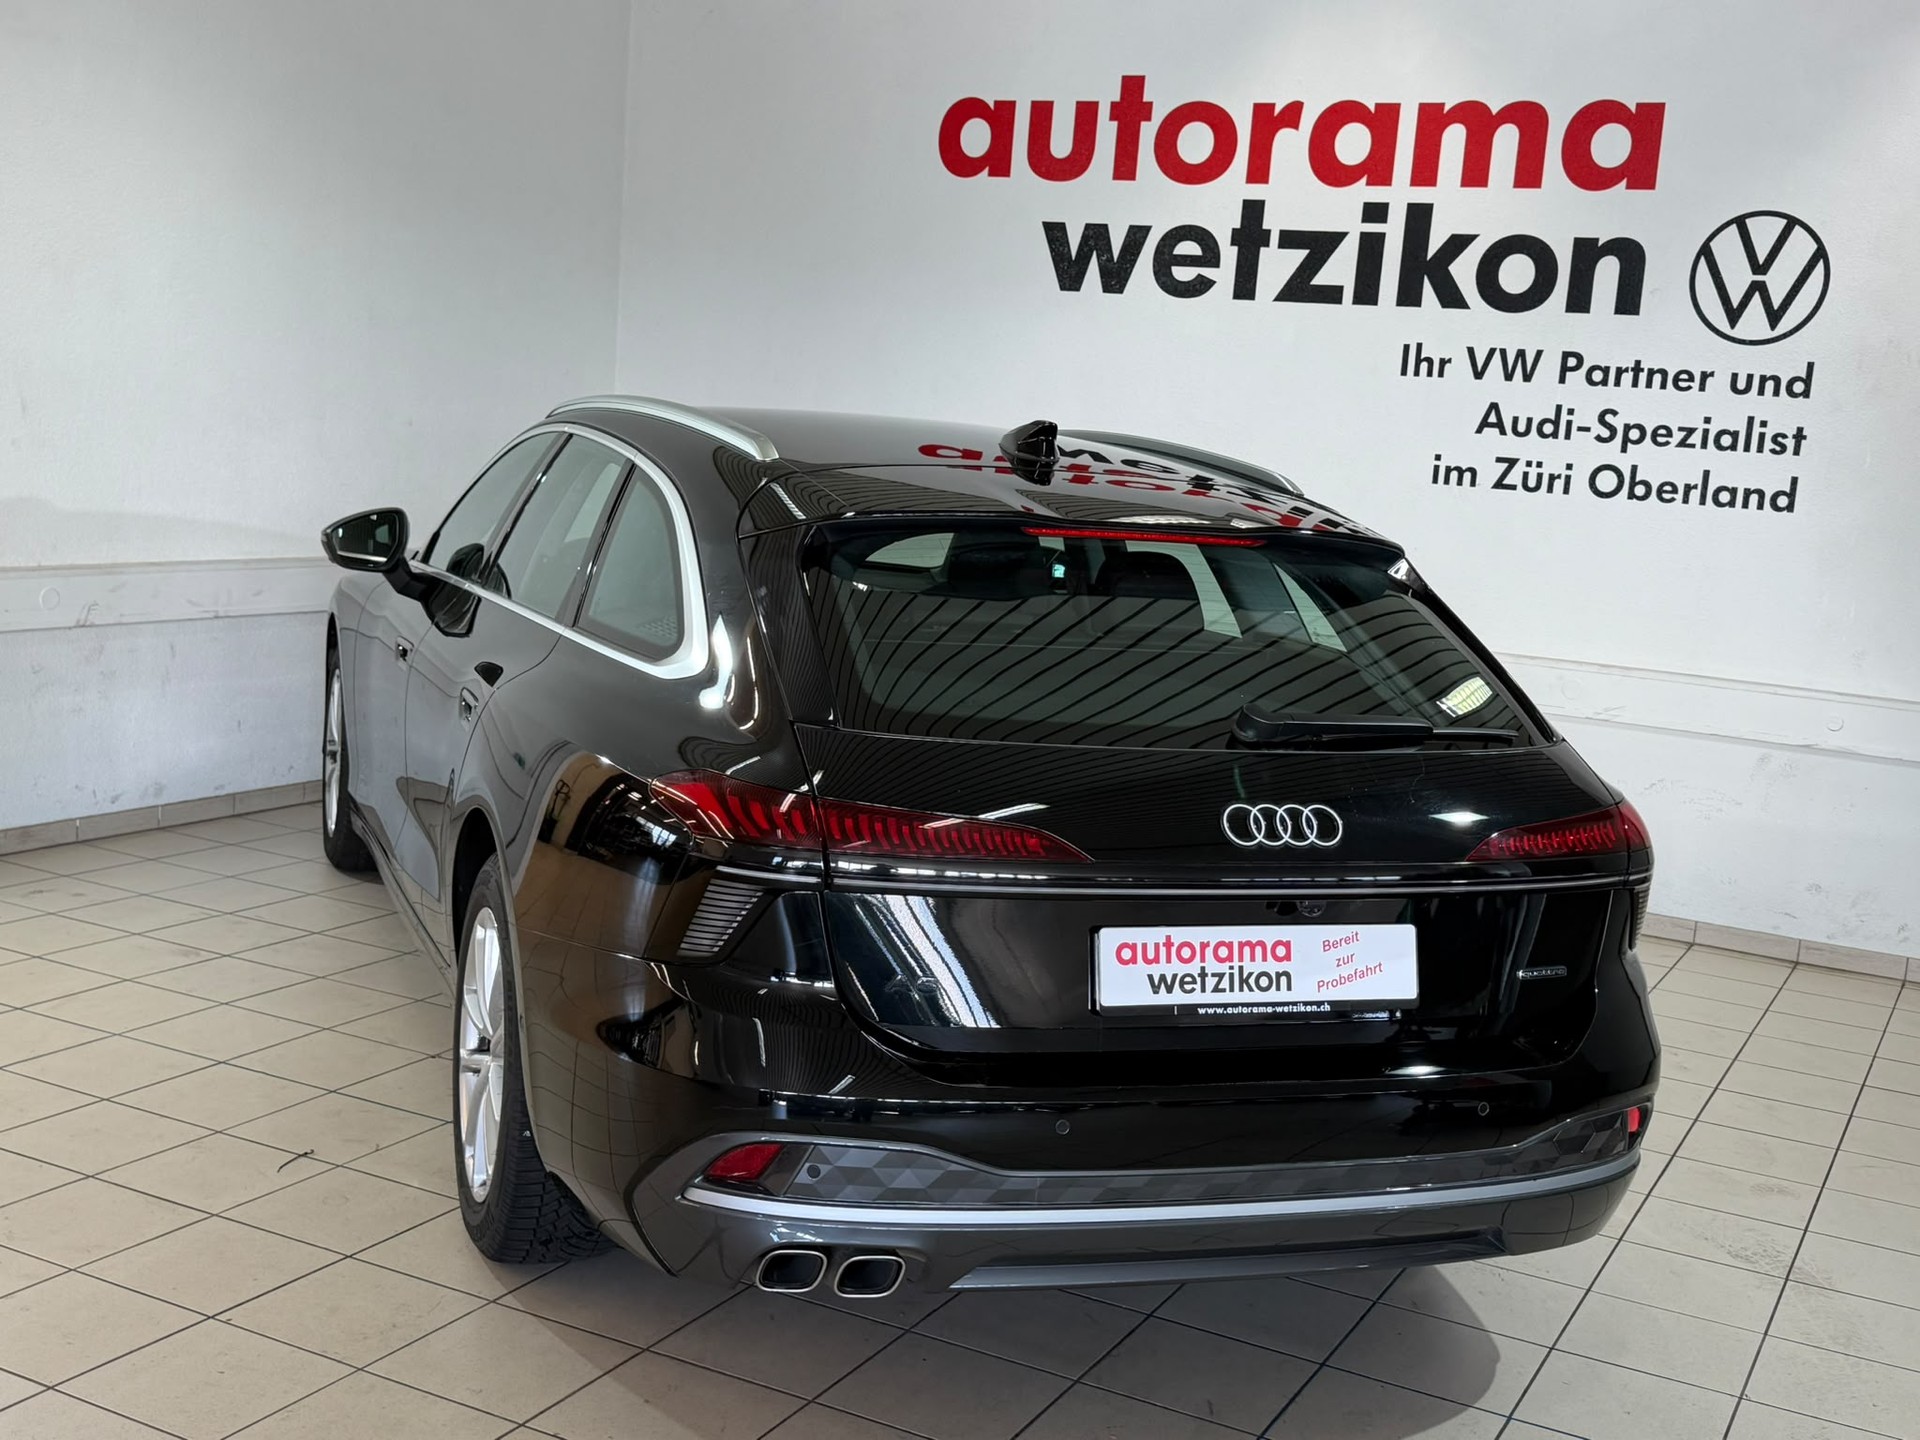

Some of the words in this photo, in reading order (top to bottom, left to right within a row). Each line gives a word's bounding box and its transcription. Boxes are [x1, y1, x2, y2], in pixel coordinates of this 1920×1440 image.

[938, 75, 1667, 192] autorama
[1041, 199, 1647, 316] wetzikon
[1689, 210, 1831, 346] VW
[1400, 342, 1452, 378] Ihr
[1466, 346, 1544, 383] VW
[1558, 350, 1715, 393] Partner
[1729, 361, 1815, 399] und
[1474, 401, 1808, 457] Audi-Spezialist
[1431, 453, 1478, 488] im
[1491, 456, 1574, 495] Züri
[1588, 463, 1799, 513] Oberland
[1115, 934, 1292, 966] autorama
[1322, 930, 1360, 953] Bereit
[1336, 952, 1355, 968] zur
[1146, 965, 1292, 995] wetzikon
[1317, 961, 1383, 993] Probefahrt
[1197, 1002, 1331, 1015] www.autorama-wetzikon.ch
